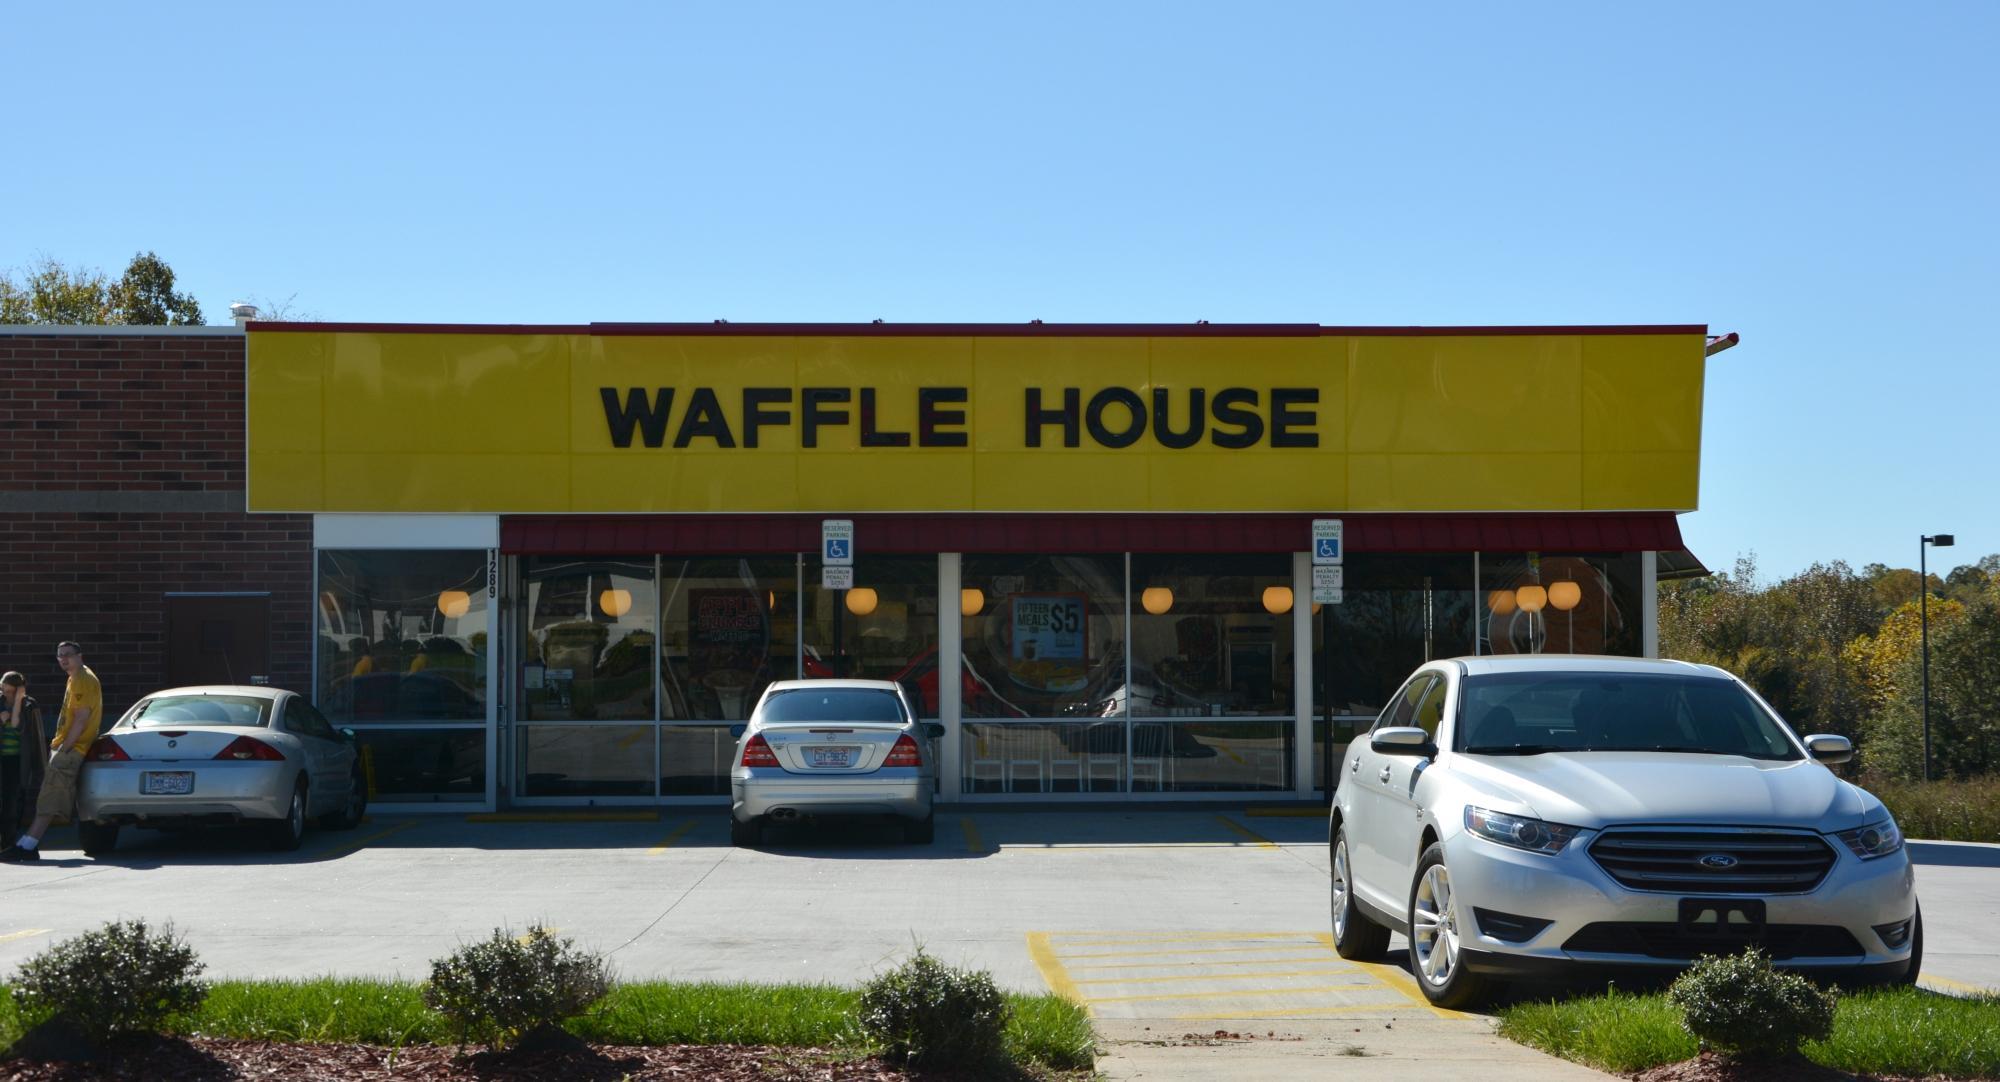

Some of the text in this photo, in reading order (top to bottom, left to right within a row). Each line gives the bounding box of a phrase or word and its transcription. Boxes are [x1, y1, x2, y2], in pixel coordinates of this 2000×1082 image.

[600, 386, 1319, 449] WAFFLE HOUSE
[1017, 603, 1049, 614] FIFTEEN
[1050, 603, 1079, 634] $5
[1017, 614, 1049, 626] MEALS
